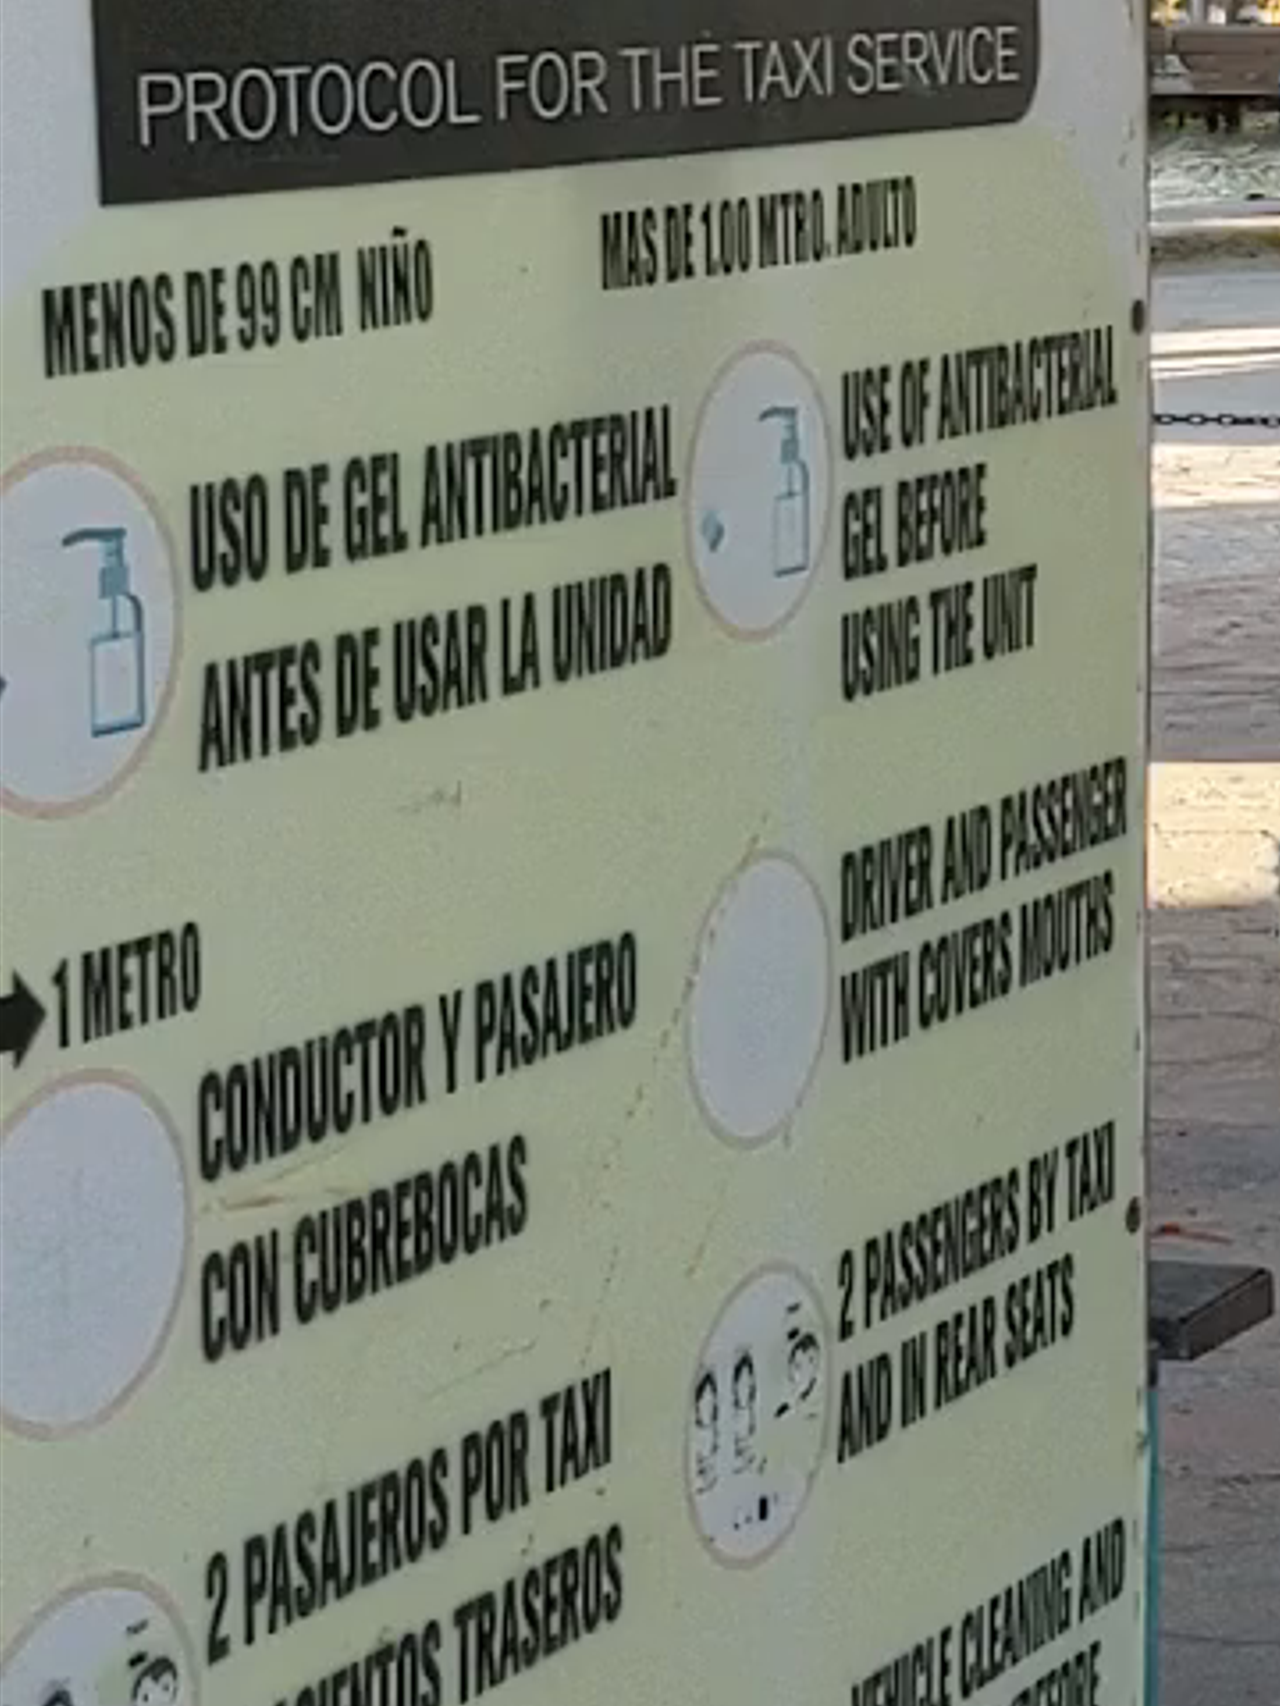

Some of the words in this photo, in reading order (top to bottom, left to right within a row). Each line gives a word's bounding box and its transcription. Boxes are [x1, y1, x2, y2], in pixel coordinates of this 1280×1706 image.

[138, 57, 480, 147] PROTOCOL
[497, 51, 607, 119] FOR
[620, 42, 722, 113] THE
[735, 37, 832, 99] TAXI
[847, 25, 1019, 93] SERVICE
[42, 275, 175, 377] MENOS
[185, 267, 227, 358] DE
[235, 261, 280, 348] 99
[289, 250, 341, 342] CM
[359, 227, 434, 331] NIÑO
[600, 206, 657, 291] MAS
[665, 202, 695, 283] DE
[837, 175, 917, 258] ADULTO
[841, 368, 888, 460] USE
[898, 361, 930, 450] OF
[938, 325, 1118, 441] ANTIBACTERIAL
[190, 473, 267, 592] USO
[284, 464, 333, 572] DE
[342, 450, 407, 563] GEL
[419, 405, 677, 549] ANTIBACTERIAL
[842, 488, 886, 581] GEL
[897, 462, 987, 569] BEFORE
[199, 631, 320, 774] ANTES
[335, 625, 381, 739] DE
[393, 593, 489, 725] USAR
[501, 588, 544, 693] LA
[551, 563, 673, 683] UNIDAD
[840, 597, 921, 702] USING
[928, 583, 974, 681] THE
[981, 564, 1038, 668] UNIT
[842, 822, 933, 943] DRIVER
[941, 803, 992, 905] AND
[1000, 755, 1126, 881] PASSENGER
[53, 957, 69, 1049] 1
[82, 921, 201, 1044] METRO
[199, 1003, 427, 1183] CONDUCTOR
[439, 991, 464, 1097] Y
[474, 930, 637, 1078] PASAJERO
[841, 950, 910, 1064] WITH
[919, 911, 1012, 1029] COVERS
[1019, 868, 1113, 987] MOUTHS
[201, 1238, 281, 1364] CON
[293, 1134, 529, 1327] CUBREBOCAS
[837, 1257, 855, 1343] 2
[863, 1171, 1020, 1331] PASSENGERS
[1028, 1152, 1057, 1245] BY
[1063, 1120, 1117, 1225] TAXI
[837, 1358, 891, 1465] AND
[901, 1341, 928, 1434] IN
[936, 1298, 996, 1414] REAR
[1004, 1252, 1075, 1372] SEATS
[206, 1550, 231, 1667] 2
[244, 1451, 448, 1647] PASAJEROS
[459, 1420, 531, 1535] POR
[538, 1367, 613, 1496] TAXI
[961, 1550, 1071, 1700] CLEANING
[1080, 1517, 1126, 1622] AND
[453, 1525, 624, 1705] TRASEROS
